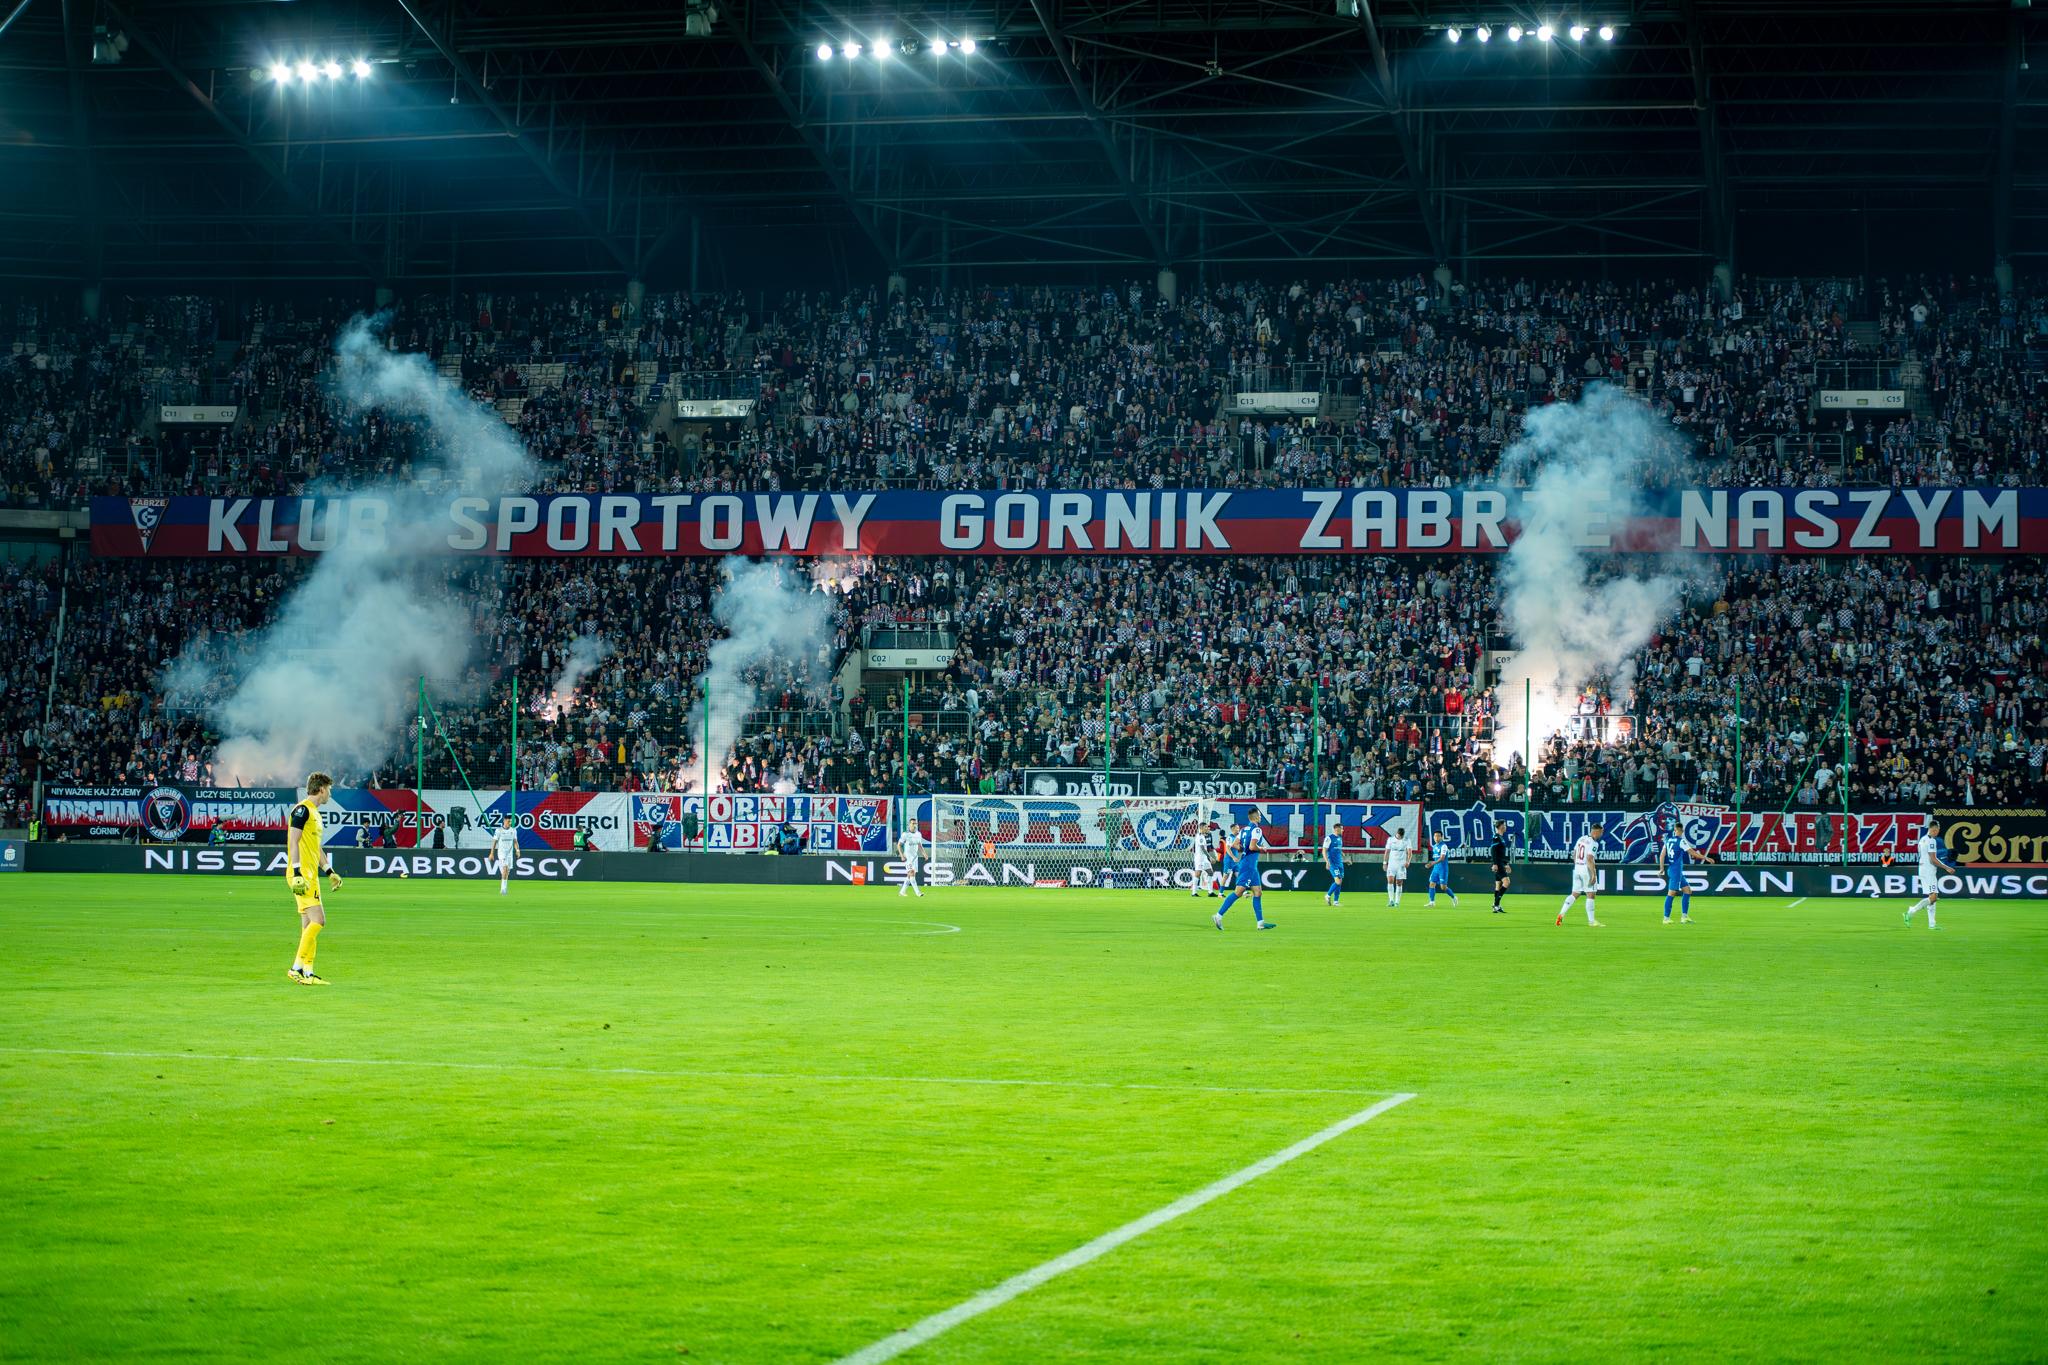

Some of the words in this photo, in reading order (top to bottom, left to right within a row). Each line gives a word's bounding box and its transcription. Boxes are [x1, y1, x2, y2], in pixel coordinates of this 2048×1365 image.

[1823, 395, 1839, 403] C14
[1886, 395, 1901, 403] C15
[164, 410, 177, 418] C11
[220, 410, 234, 418] C12
[680, 405, 695, 413] C12
[131, 499, 166, 507] ZABRZE
[208, 498, 388, 553] KLUB
[447, 494, 877, 552] SPORTOWY
[1299, 490, 1611, 548] ZABRZE
[1680, 489, 2018, 549] NASZYM
[871, 654, 887, 662] C02
[51, 787, 63, 796] NIY
[64, 786, 93, 796] WAŻNE
[93, 788, 110, 796] KAJ
[110, 786, 142, 796] ŻYJEMY
[1065, 782, 1133, 796] DAWID
[1177, 780, 1257, 795] PASTOR
[149, 788, 181, 801] TORCIDA
[196, 790, 219, 799] LICZY
[219, 791, 233, 800] SIĘ
[233, 791, 251, 799] DLA
[251, 791, 275, 799] KOGO
[642, 797, 672, 805] ZABRZE
[848, 799, 878, 808] ZABRZE
[46, 799, 143, 825] TORCIDA
[192, 802, 294, 828] GERMANY
[1677, 804, 1722, 818] ZABRZE
[319, 811, 397, 829] ĘDZIEMY
[403, 811, 418, 828] Z
[420, 811, 473, 831] TOĄ
[477, 809, 503, 829] AŻ
[540, 809, 619, 830] ŚMIERCI
[89, 826, 120, 835] GÓRNIK
[1429, 801, 1627, 851] GÓRNIK
[1718, 811, 1926, 853] ZABRZE
[225, 832, 256, 841] ZABRZE
[1577, 843, 1585, 861] 10
[1666, 842, 1675, 859] 14
[1720, 851, 1754, 862] CHLUBA
[1754, 852, 1787, 862] MIASTA
[1788, 853, 1801, 862] NA
[1801, 852, 1840, 863] KARTACH
[826, 860, 1034, 885] NISSAN
